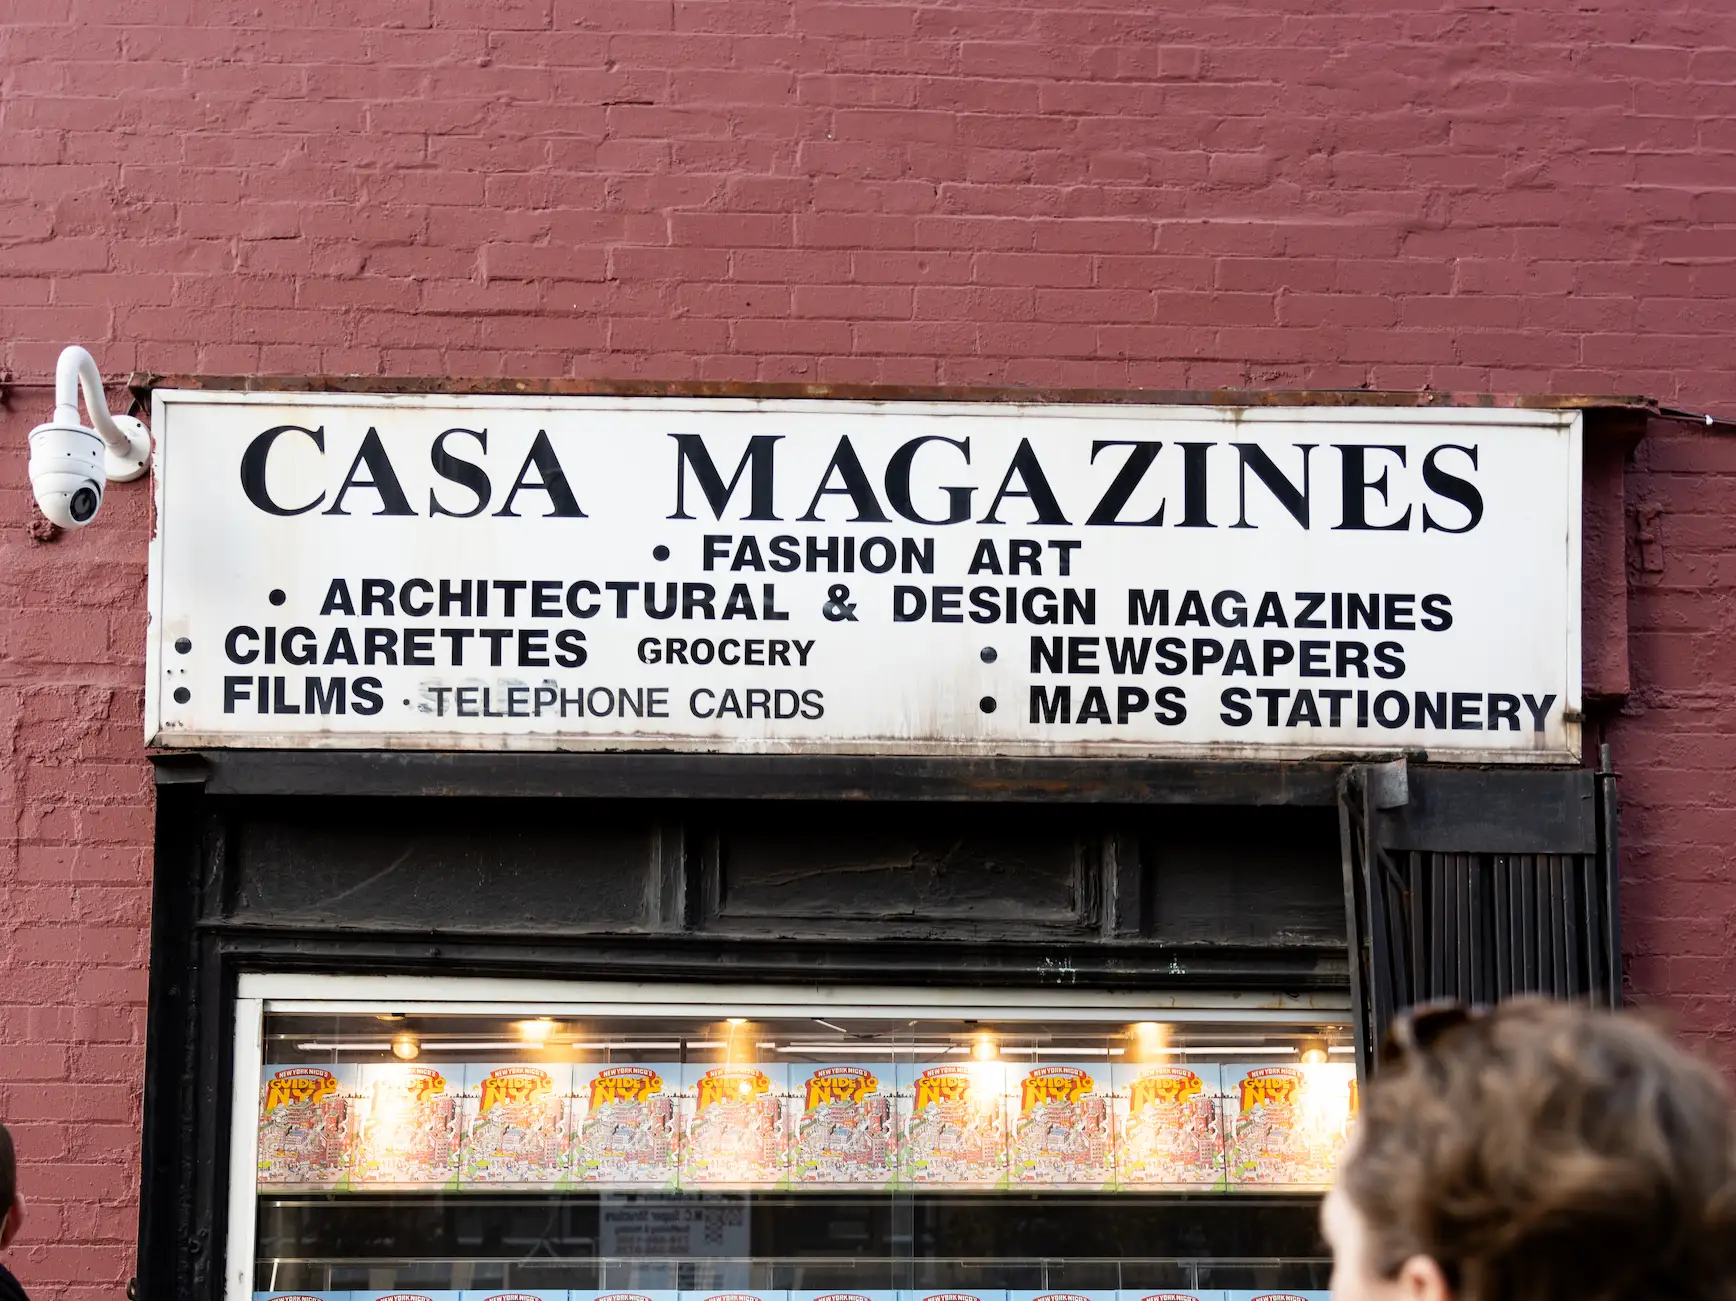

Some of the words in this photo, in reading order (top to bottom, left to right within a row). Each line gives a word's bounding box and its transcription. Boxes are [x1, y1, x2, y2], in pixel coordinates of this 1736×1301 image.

[240, 425, 589, 518] CASA
[665, 433, 1484, 534] MAGAZINES
[703, 534, 935, 574] FASHION
[967, 538, 1082, 577] ART
[319, 578, 790, 621] ARCHITECTURAL
[822, 583, 859, 622] &
[893, 585, 1096, 625] DESIGN
[1128, 588, 1453, 632] MAGAZINES
[224, 625, 588, 669] CIGARETTES
[637, 637, 816, 667] GROCERY
[1030, 635, 1406, 680] NEWSPAPERS
[223, 675, 384, 716] FILMS
[428, 686, 669, 718] TELEPHONE
[689, 688, 825, 720] CARDS
[1029, 685, 1187, 726] MAPS
[1219, 687, 1557, 733] STATIONERY
[270, 1079, 315, 1088] GUIDE
[317, 1079, 337, 1088] TO
[595, 1078, 640, 1087] GUIDE
[642, 1078, 662, 1087] TO
[810, 1078, 856, 1087] GUIDE
[858, 1078, 878, 1087] TO
[1026, 1078, 1072, 1087] GUIDE
[1074, 1078, 1094, 1087] TO
[269, 1088, 336, 1111] NYC
[594, 1087, 661, 1110] NYC
[809, 1087, 877, 1110] NYC
[1025, 1087, 1093, 1110] NYC
